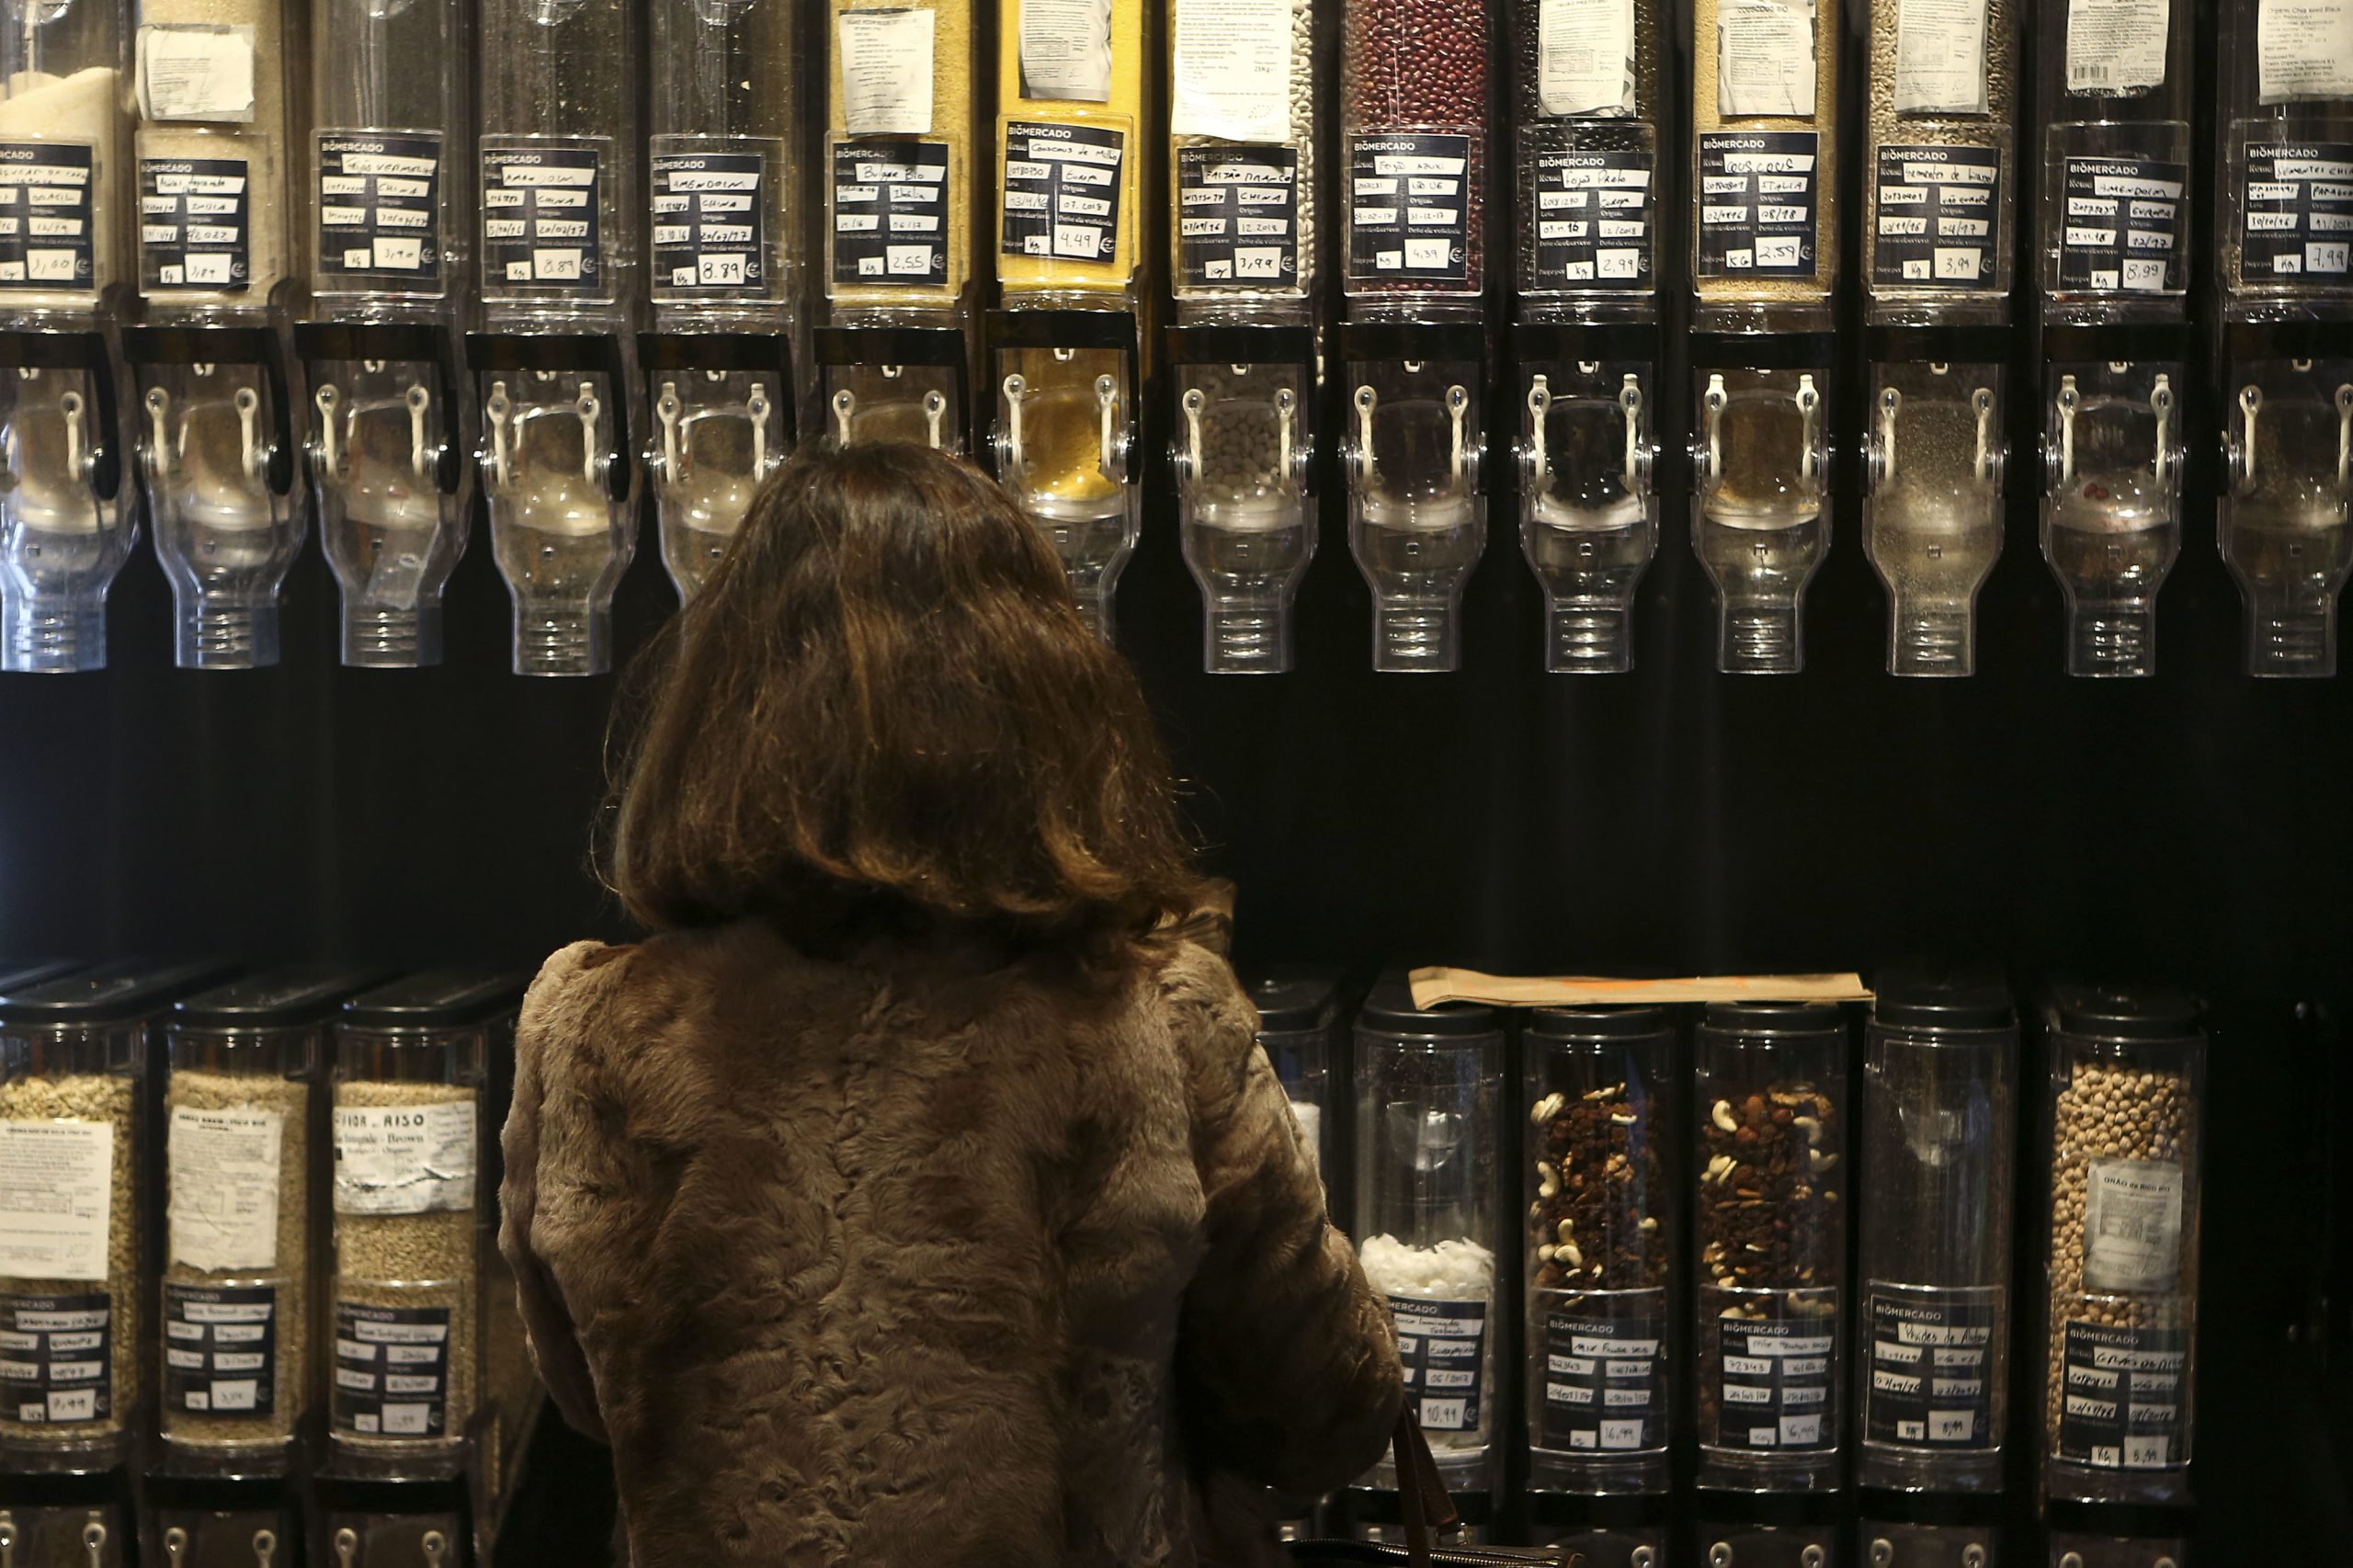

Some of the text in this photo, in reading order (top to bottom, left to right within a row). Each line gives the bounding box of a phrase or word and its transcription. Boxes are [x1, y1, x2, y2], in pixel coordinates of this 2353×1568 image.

[1007, 126, 1072, 139] BIOMERCADO
[322, 142, 383, 153] BIOMERCADO
[1354, 141, 1415, 152] BIOMERCADO
[1702, 139, 1766, 150] BIOMERCADO
[1181, 153, 1245, 163] BIOMERCADO
[1881, 150, 1949, 162] BIOMERCADO
[2249, 147, 2318, 158] BIOMERCADO
[484, 153, 542, 165] BIOMERCADO
[1539, 156, 1606, 168] BIOMERCADO
[654, 160, 706, 171] BIOMERCADO
[2070, 163, 2139, 176] BIOMERCADO
[1240, 189, 1281, 201] CHINA
[1238, 256, 1274, 271] 3,99
[1603, 258, 1633, 275] 2,99
[2126, 264, 2159, 281] 8,99
[383, 1114, 425, 1128] RISO
[1389, 1302, 1438, 1314] MERCADO
[1876, 1305, 1941, 1321] BIOMERCADO
[1549, 1320, 1614, 1335] BIOMERCADO
[1723, 1323, 1789, 1335] BIOMERCADO
[2070, 1330, 2140, 1345] BIOMERCADO
